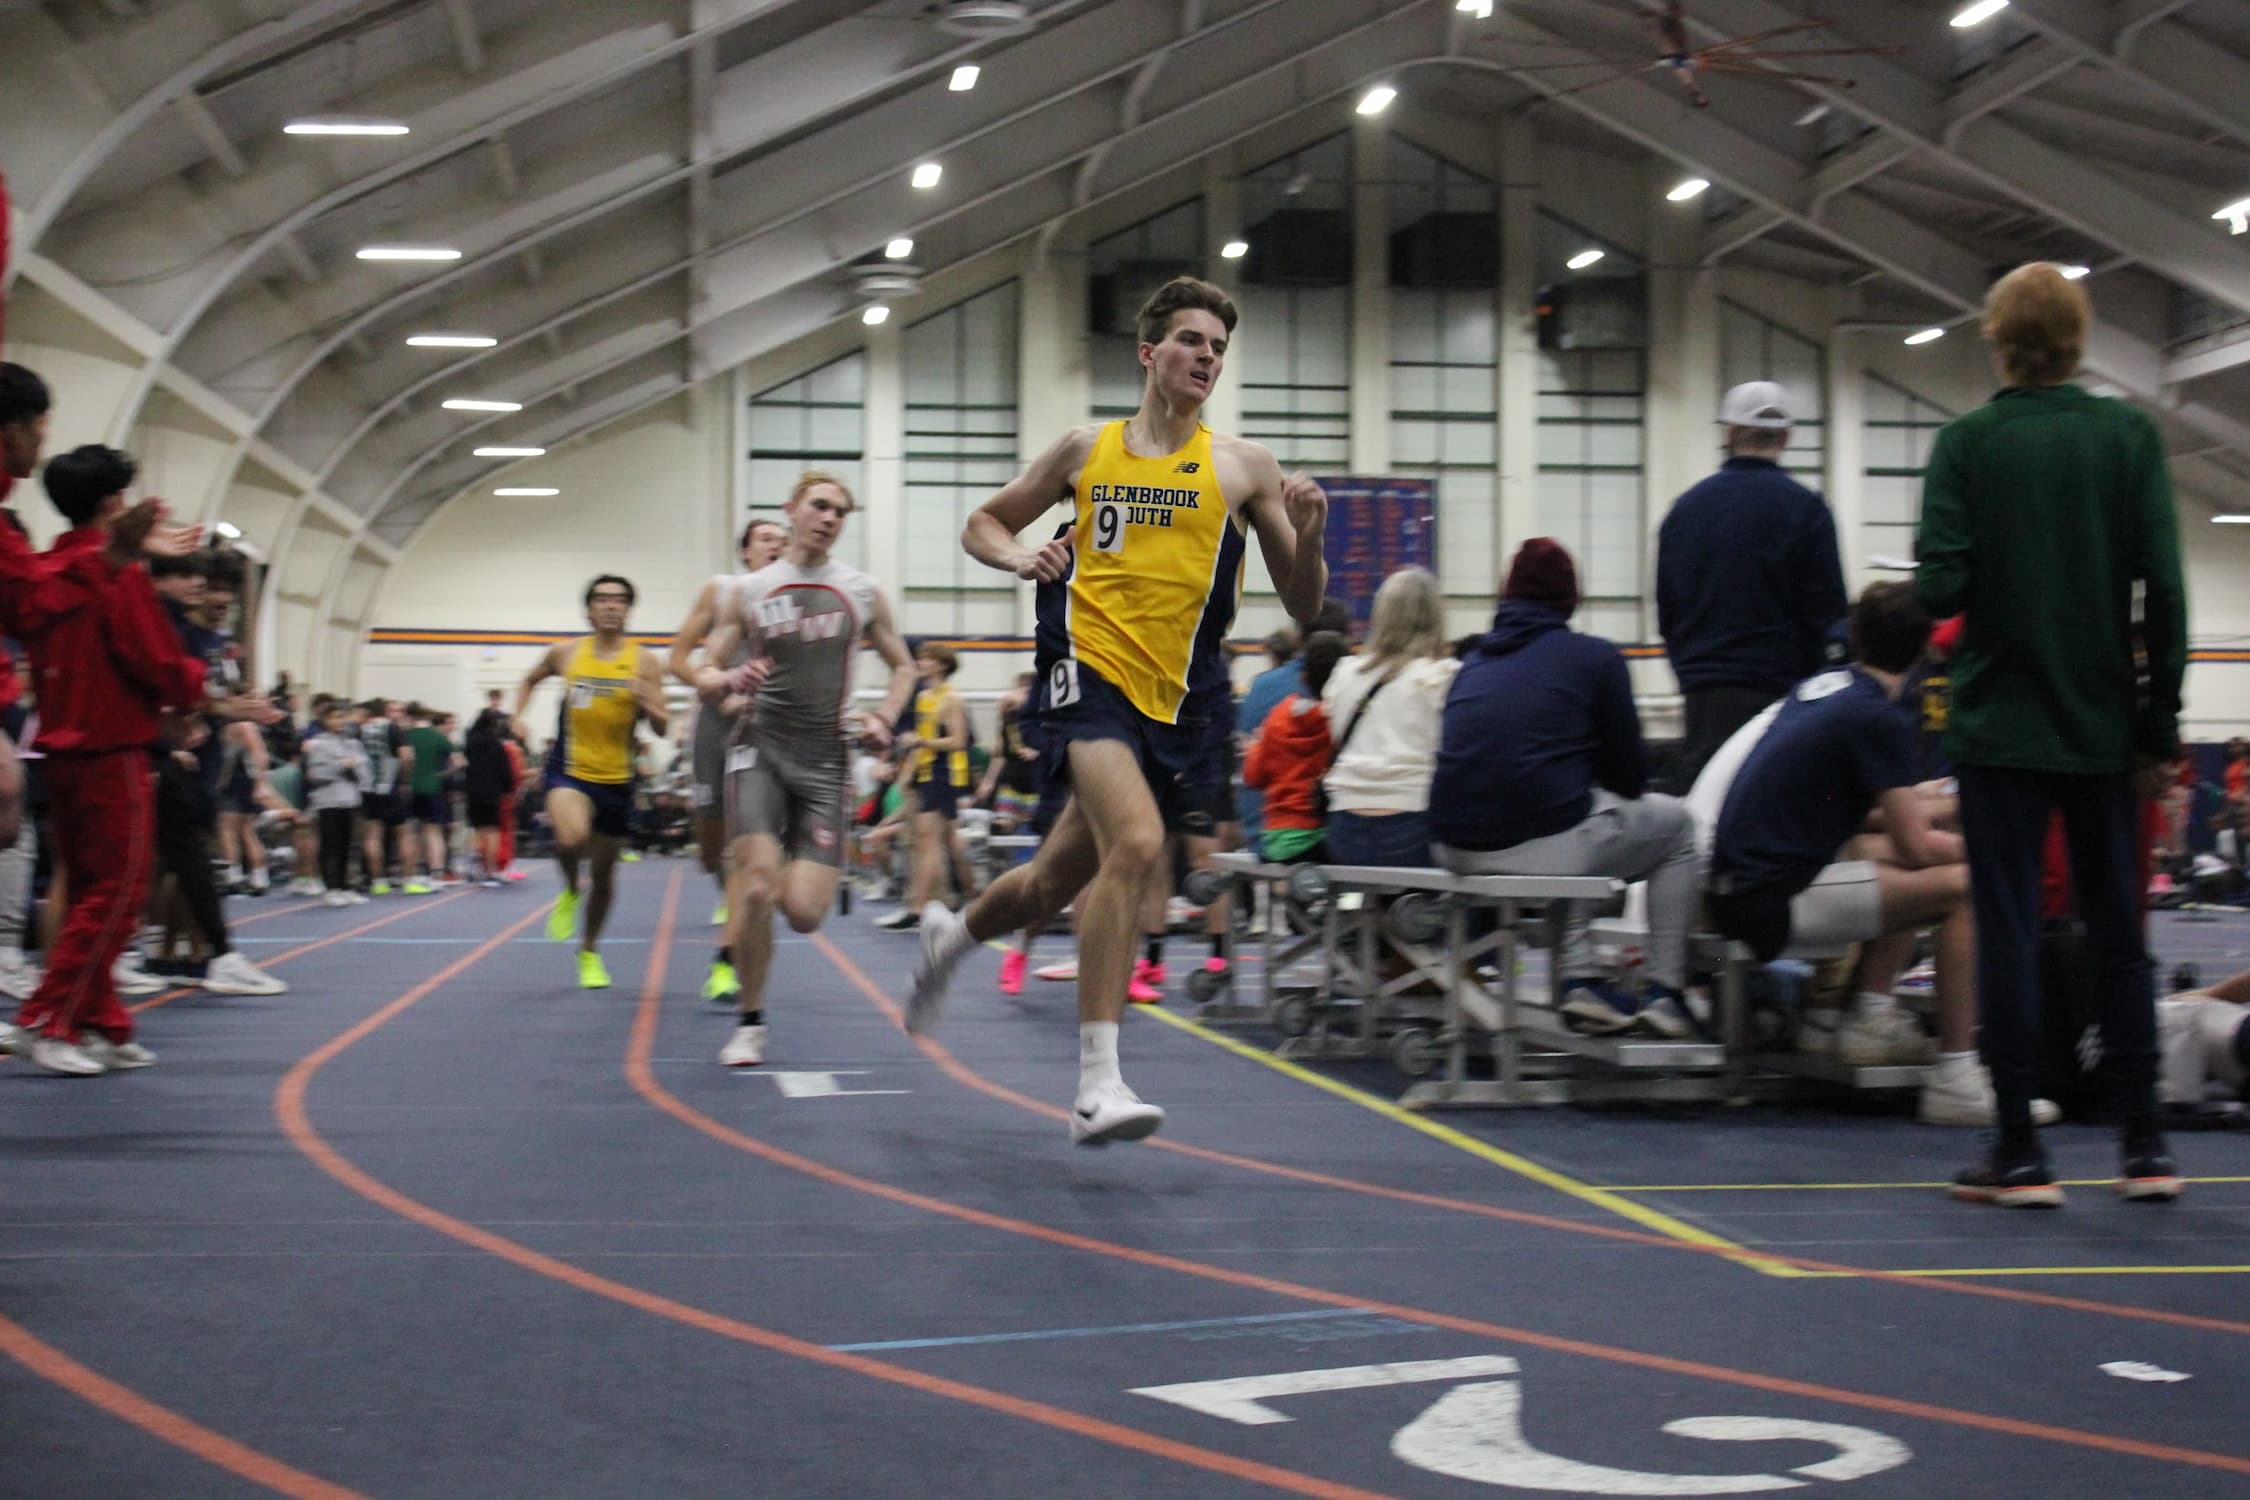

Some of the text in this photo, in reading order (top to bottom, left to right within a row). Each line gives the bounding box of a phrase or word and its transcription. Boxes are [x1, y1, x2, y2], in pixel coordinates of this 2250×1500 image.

[1091, 484, 1200, 509] GLENBROOK
[1125, 506, 1173, 527] OUTH
[1098, 505, 1118, 549] 9
[1054, 662, 1070, 705] 9
[1124, 1354, 1915, 1496] 2
